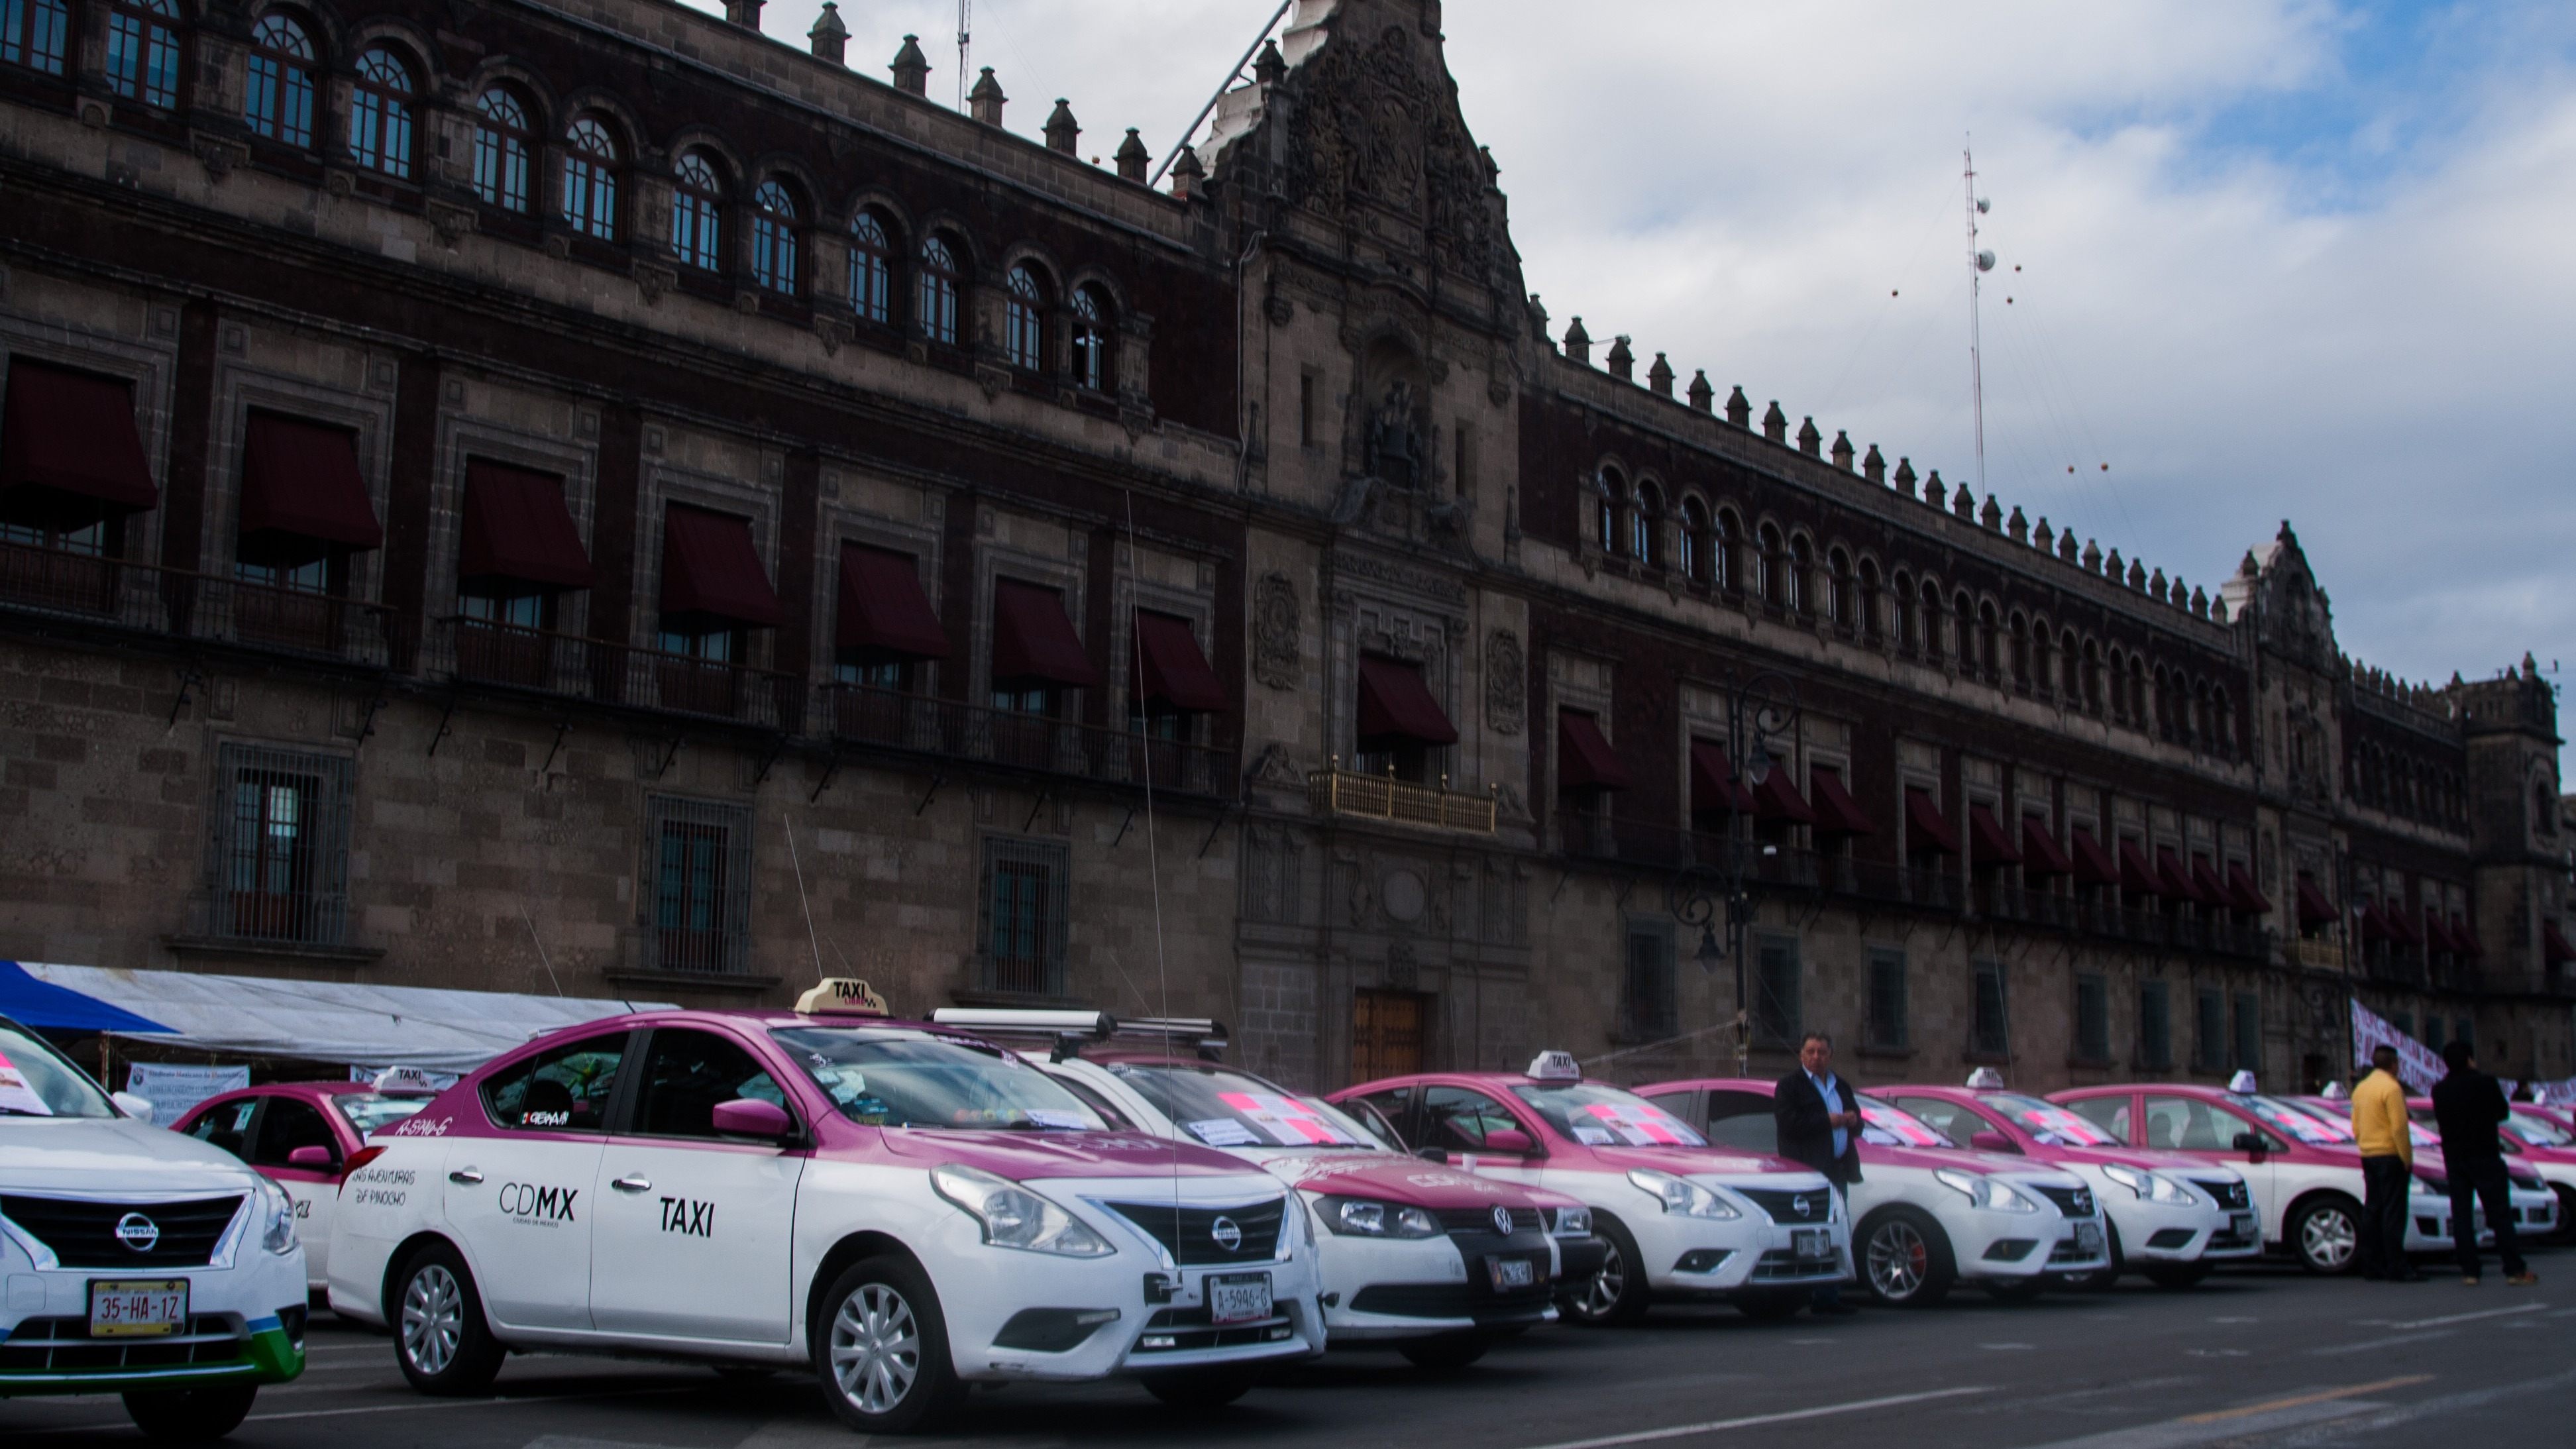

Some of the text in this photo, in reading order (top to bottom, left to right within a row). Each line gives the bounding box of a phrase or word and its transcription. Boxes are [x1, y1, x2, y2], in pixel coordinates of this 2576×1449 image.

[833, 981, 865, 998] TAXI
[1552, 1054, 1570, 1069] TAXI
[399, 1069, 421, 1080] TAXI
[368, 1168, 416, 1185] AVENTURAS
[370, 1189, 406, 1207] PINOCHO
[499, 1182, 578, 1221] CDMX
[513, 1216, 531, 1226] CIUDAD
[660, 1196, 715, 1238] TAXI
[123, 1226, 157, 1236] NISSAN
[1218, 1229, 1240, 1239] NISSAN
